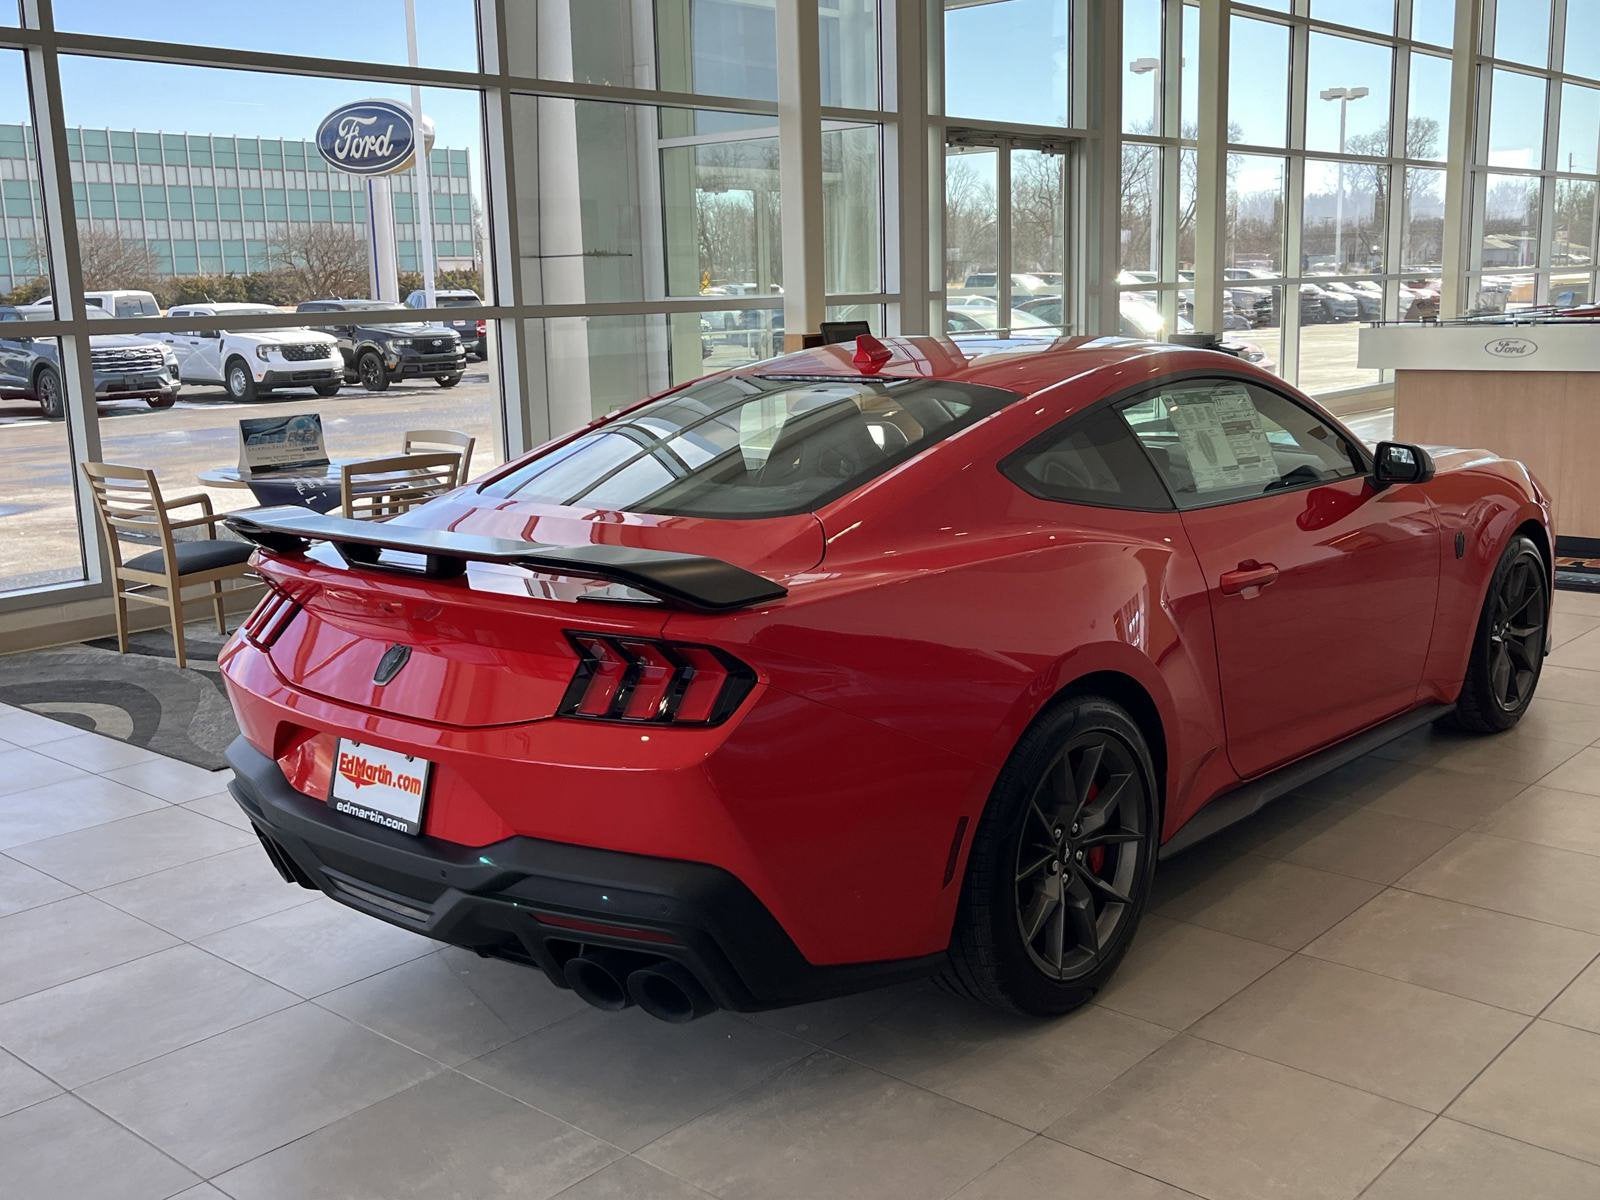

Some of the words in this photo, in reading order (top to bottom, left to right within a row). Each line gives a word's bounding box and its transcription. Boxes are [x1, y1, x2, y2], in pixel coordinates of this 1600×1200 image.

[334, 116, 394, 160] Ford
[1494, 340, 1527, 353] Ford
[336, 801, 408, 833] edmartin.com
